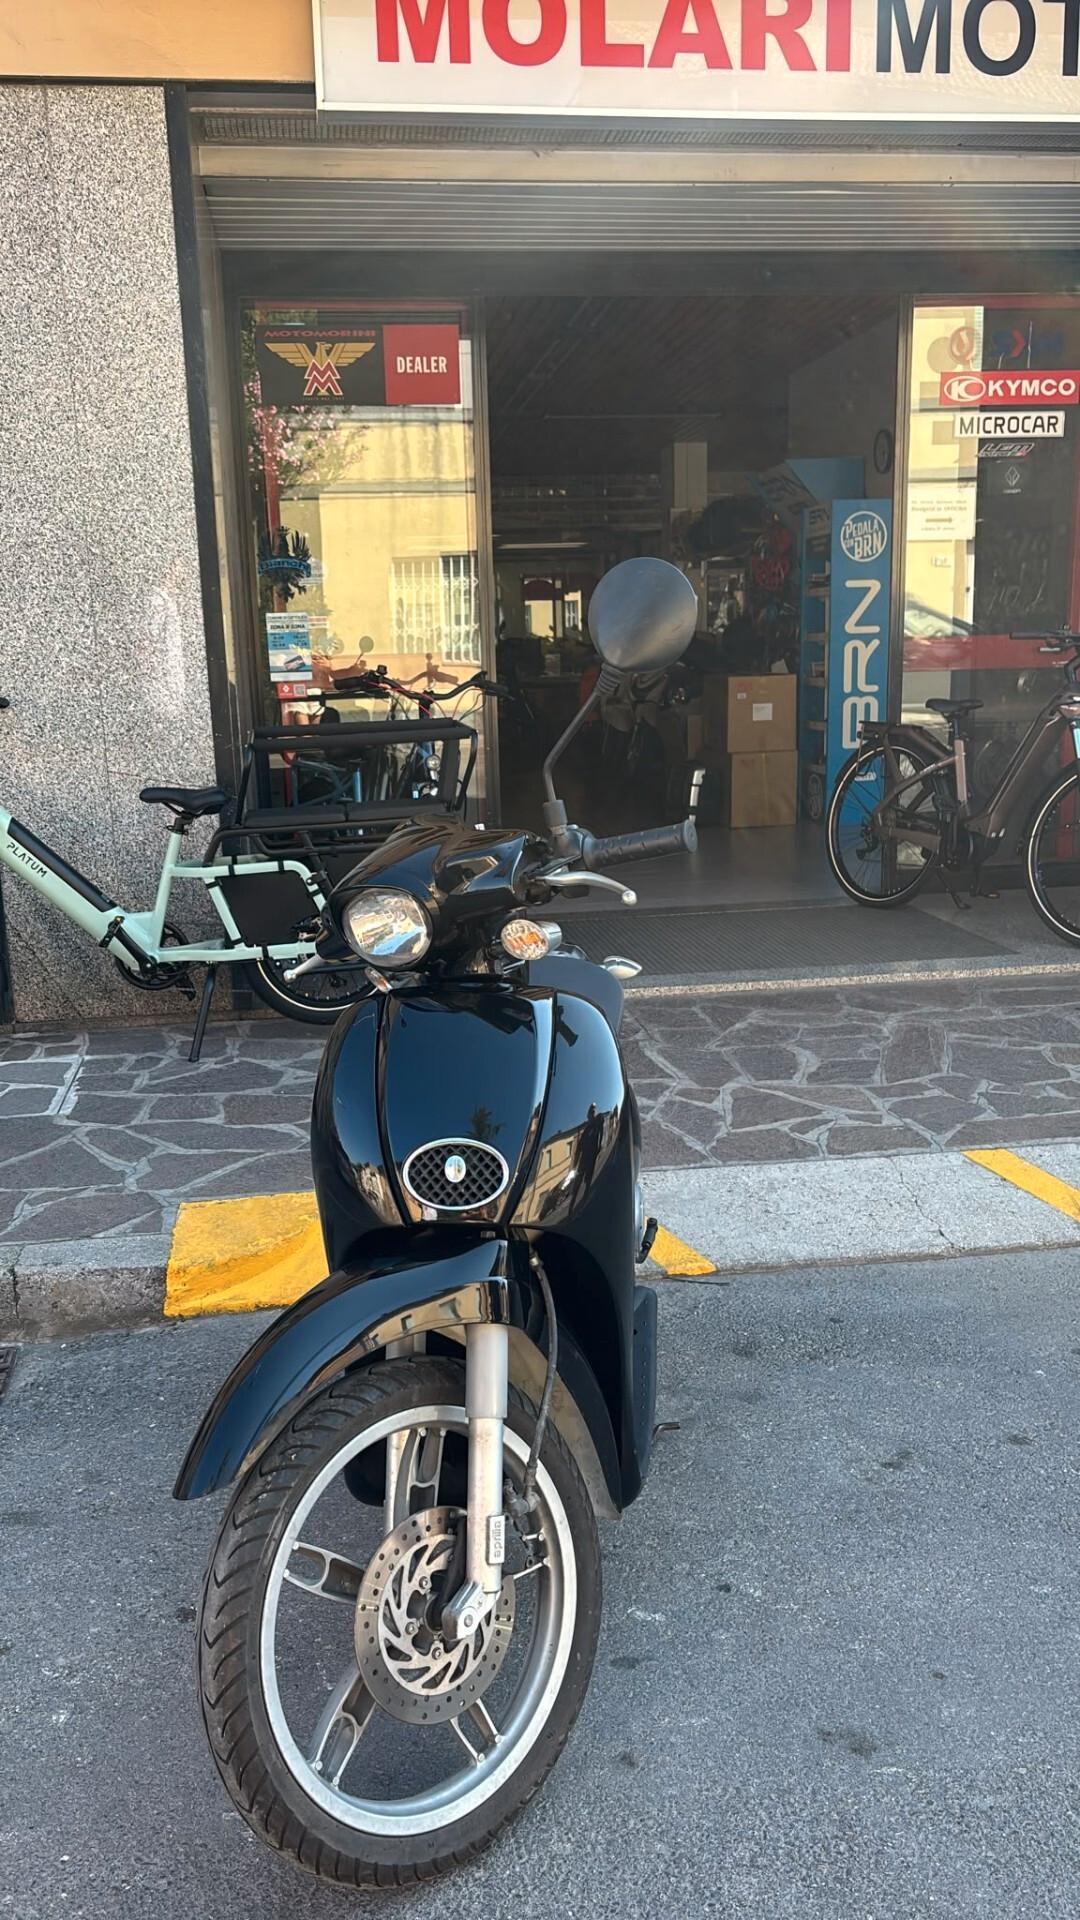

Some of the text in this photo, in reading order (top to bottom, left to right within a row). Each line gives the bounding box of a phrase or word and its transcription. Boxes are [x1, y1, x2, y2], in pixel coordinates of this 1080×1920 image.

[375, 0, 853, 73] MOLARI
[396, 356, 448, 374] DEALER
[988, 378, 1076, 398] KYMCO
[959, 415, 1059, 435] MICROCAR
[845, 518, 880, 539] PEDALA
[854, 531, 882, 560] BRN
[842, 579, 882, 750] BRN
[6, 842, 48, 878] PLATUM
[492, 1520, 503, 1558] aprilia
